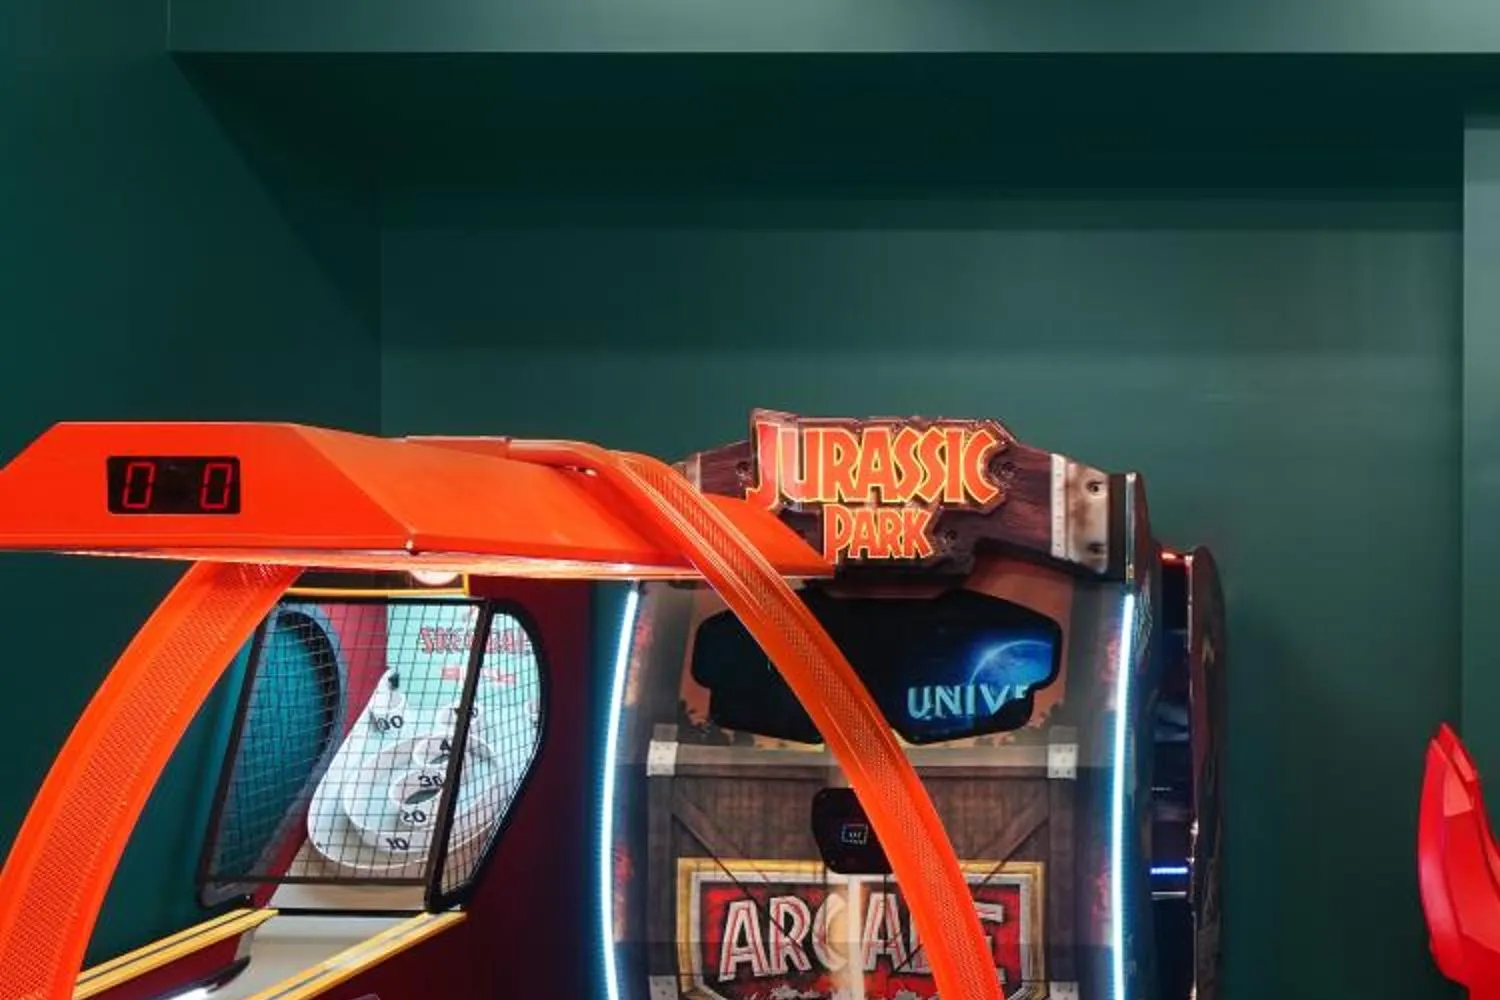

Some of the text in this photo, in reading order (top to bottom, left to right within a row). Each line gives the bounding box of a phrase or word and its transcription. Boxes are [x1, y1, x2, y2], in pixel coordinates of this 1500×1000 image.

[123, 462, 232, 509] 0 0
[746, 420, 1000, 512] JURASSIC
[823, 504, 934, 566] PARK
[719, 891, 1006, 984] ARCA
